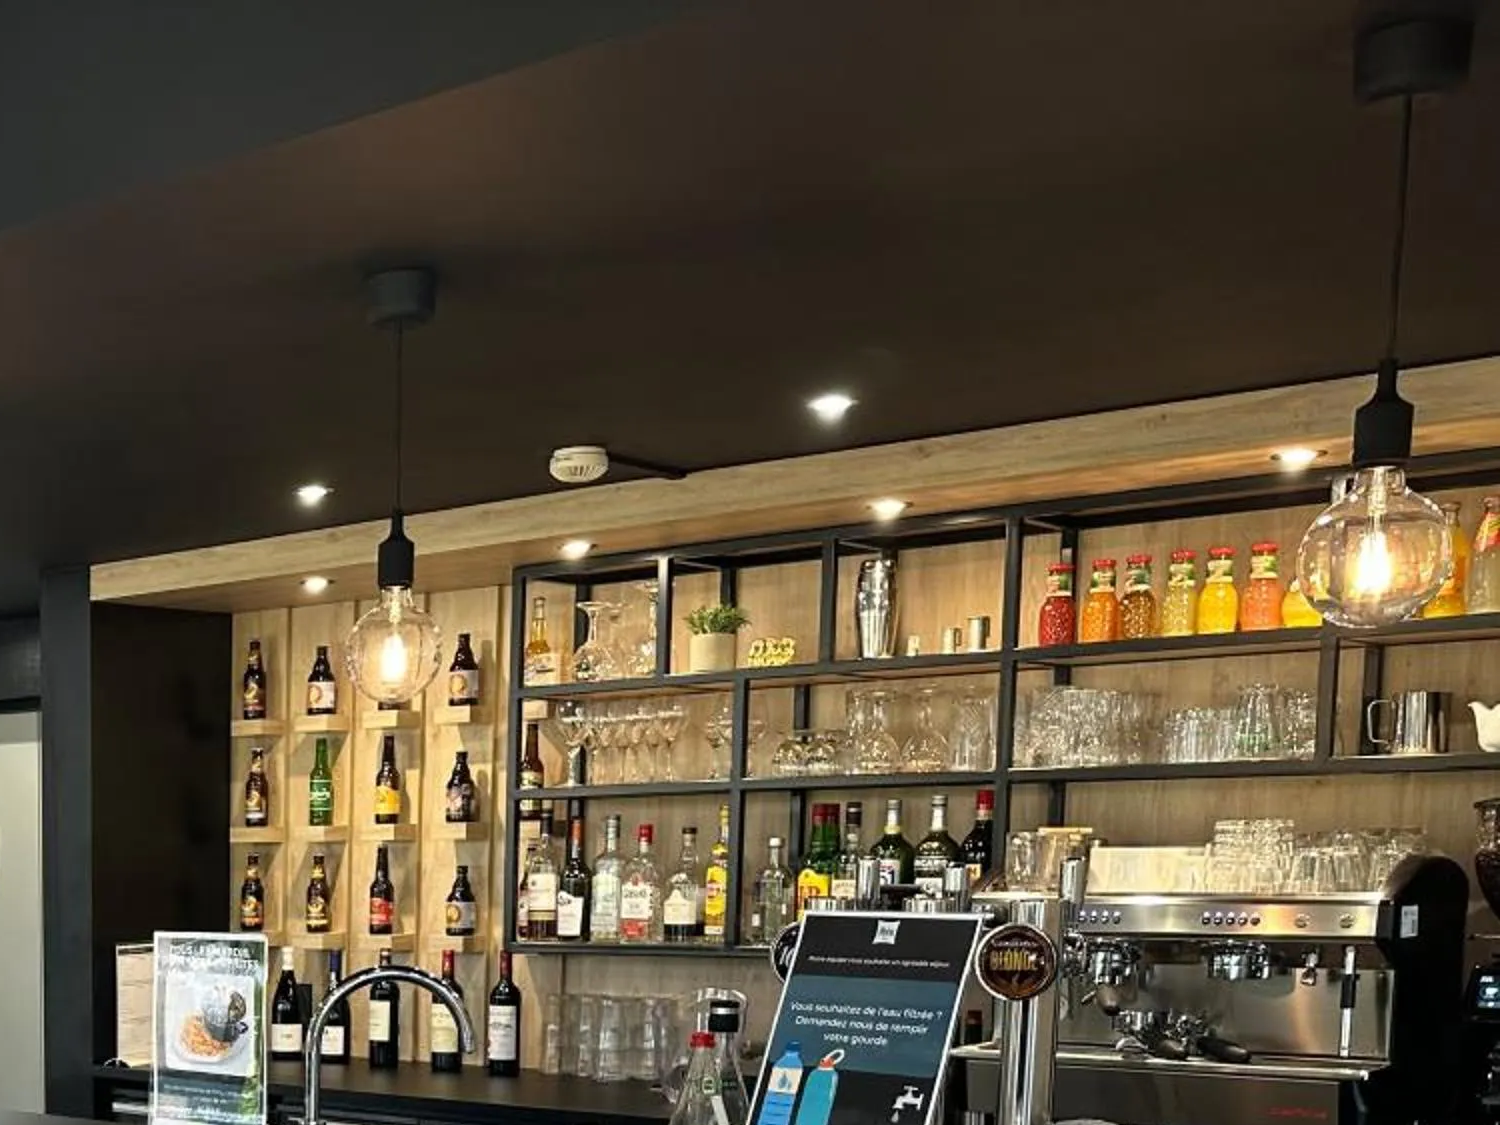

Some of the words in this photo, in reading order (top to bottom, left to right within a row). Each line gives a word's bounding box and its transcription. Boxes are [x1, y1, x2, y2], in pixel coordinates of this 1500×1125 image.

[791, 1001, 814, 1012] Vous
[815, 1003, 862, 1015] souhaitez
[862, 1006, 877, 1016] de
[795, 1015, 847, 1029] Demandez
[849, 1020, 874, 1032] nous
[875, 1022, 889, 1032] de
[823, 1032, 850, 1043] votre
[851, 1033, 889, 1047] gourde
